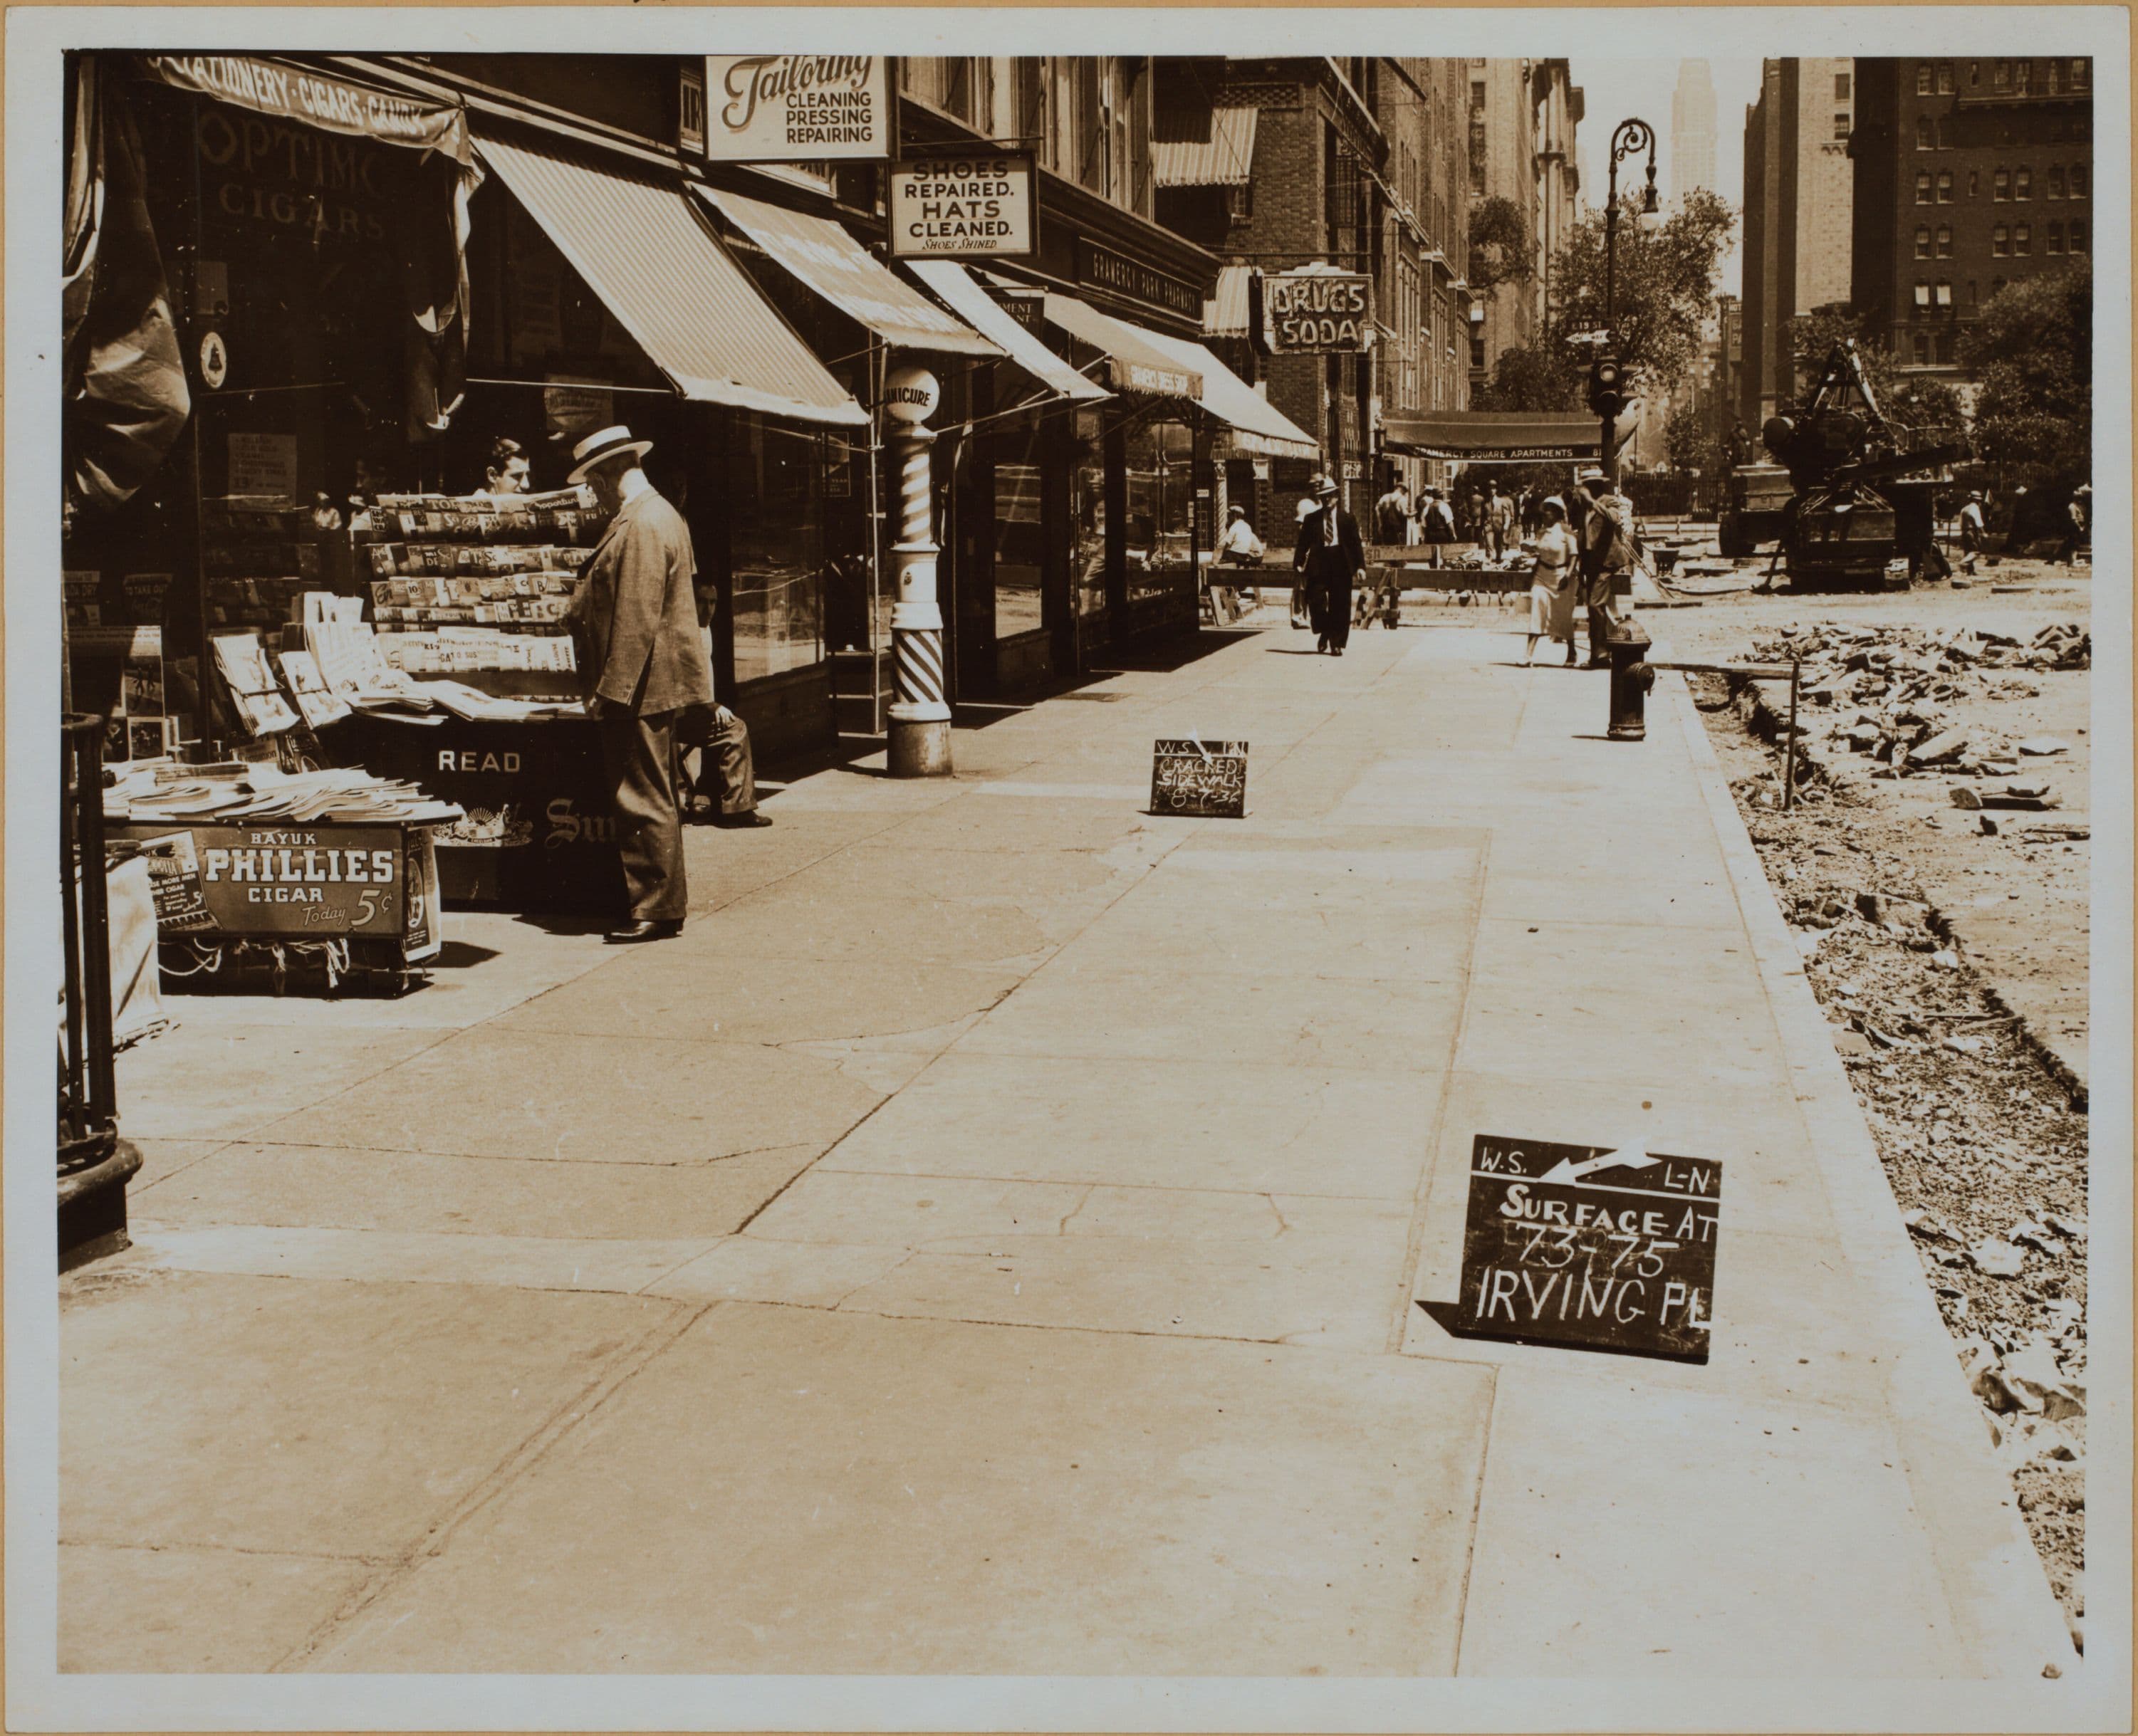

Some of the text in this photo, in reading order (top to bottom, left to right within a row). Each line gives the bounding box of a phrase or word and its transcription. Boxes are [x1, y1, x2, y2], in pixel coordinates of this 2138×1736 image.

[298, 77, 364, 126] CIGARS
[721, 56, 872, 130] Tailoring
[786, 91, 872, 108] CLEANING
[786, 108, 872, 125] PRESSING
[786, 127, 872, 143] REPAIRING
[912, 160, 1008, 181] SHOES
[904, 182, 1015, 199] REPAIRED.
[219, 183, 383, 239] CIGARS
[922, 199, 1001, 219] HATS
[909, 221, 1013, 238] CLEANED.
[1093, 252, 1196, 314] GRAMERCY PARK PHARMACY
[1274, 283, 1366, 313] DRUGS
[1283, 318, 1360, 344] SODA
[1579, 321, 1590, 330] 19
[1413, 446, 1464, 459] GRAMERCY
[1470, 449, 1506, 460] SQUARE
[1510, 449, 1573, 459] APARTMENTS
[438, 750, 521, 773] READ
[1160, 756, 1238, 775] CRACKED
[1156, 773, 1244, 788] SIDEWALK
[251, 832, 317, 845] BAYUK
[205, 848, 394, 883] PHILLIES
[247, 887, 324, 903] CIGAR
[301, 906, 346, 926] Today
[350, 889, 394, 926] 5¢
[1481, 1146, 1710, 1194] W.S. L-N
[1499, 1183, 1719, 1243] SURFACE AT
[1515, 1221, 1679, 1277] 73-75
[1475, 1265, 1711, 1331] IRVING PL
